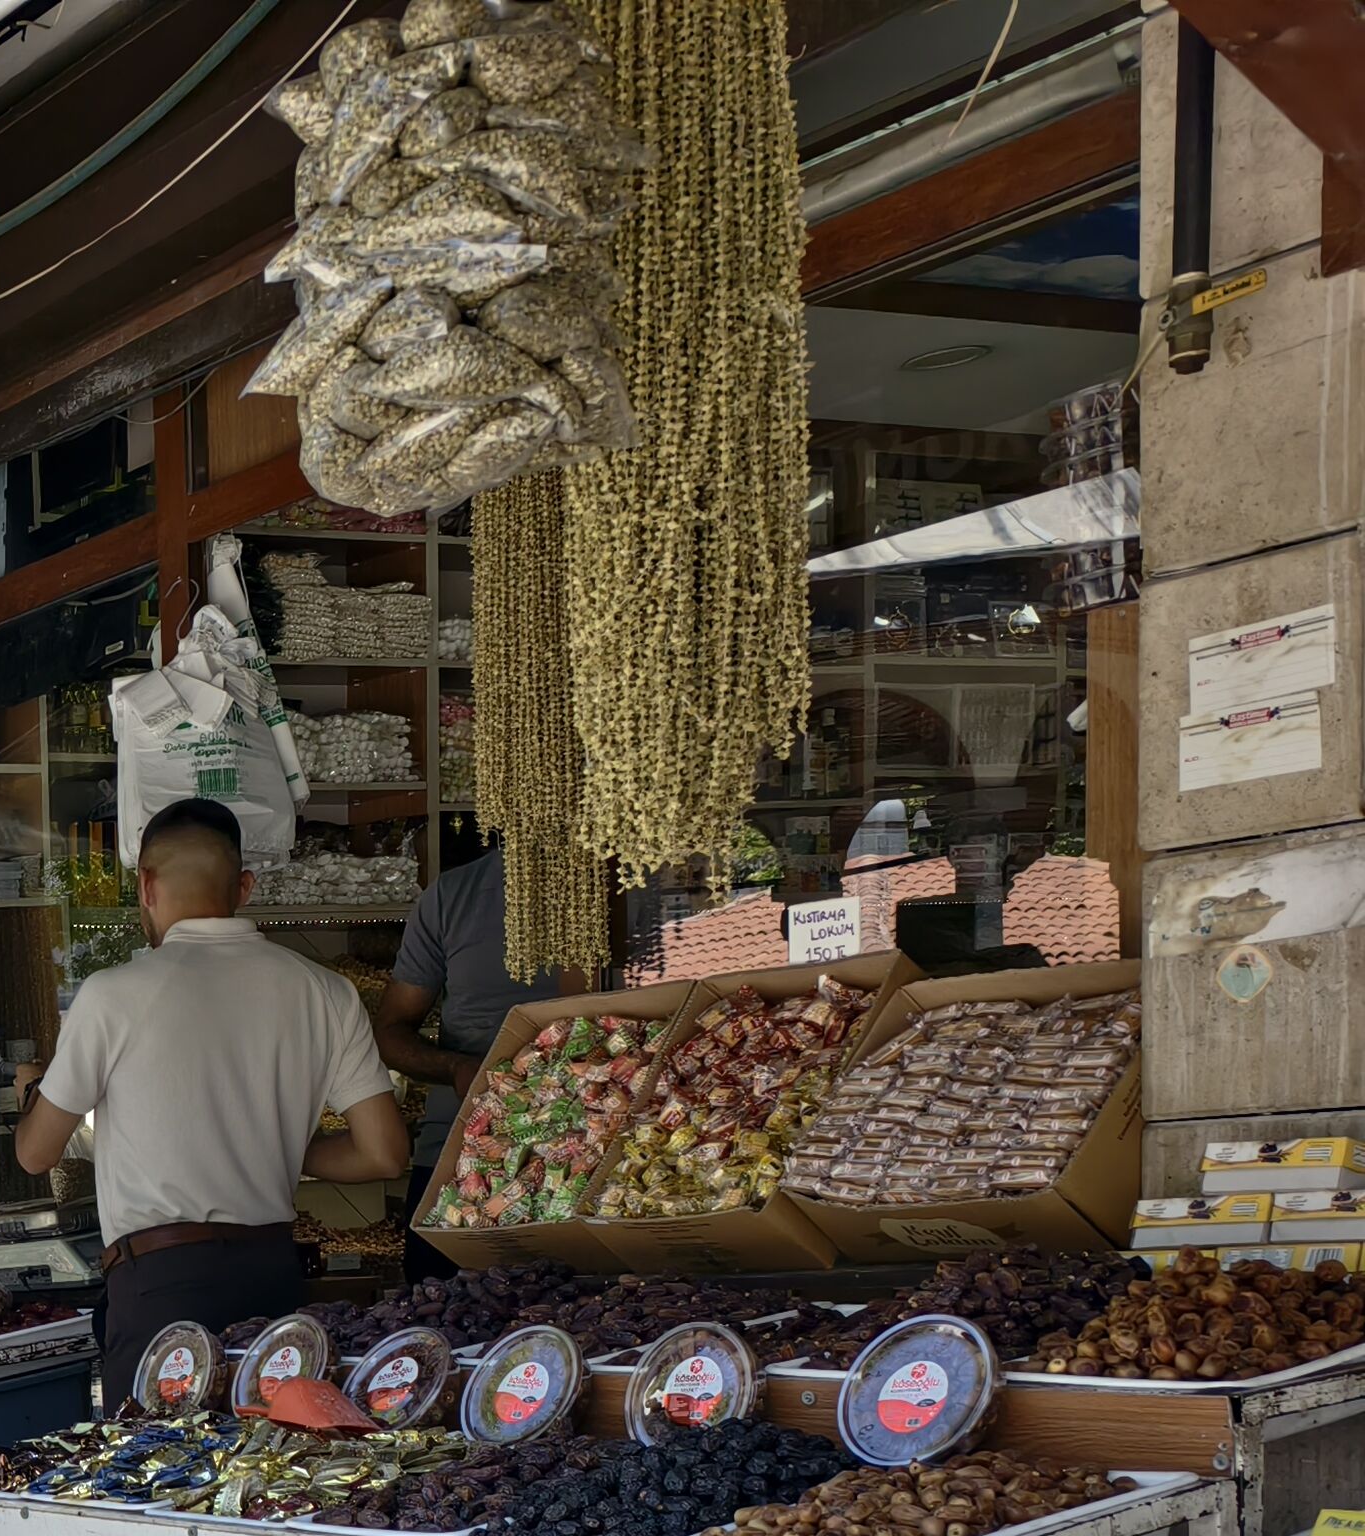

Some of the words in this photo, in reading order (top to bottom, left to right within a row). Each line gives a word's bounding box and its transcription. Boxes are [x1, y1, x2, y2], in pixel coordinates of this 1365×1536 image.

[793, 908, 846, 925] KISTIRMA
[805, 946, 832, 962] 150
[835, 945, 848, 960] TL
